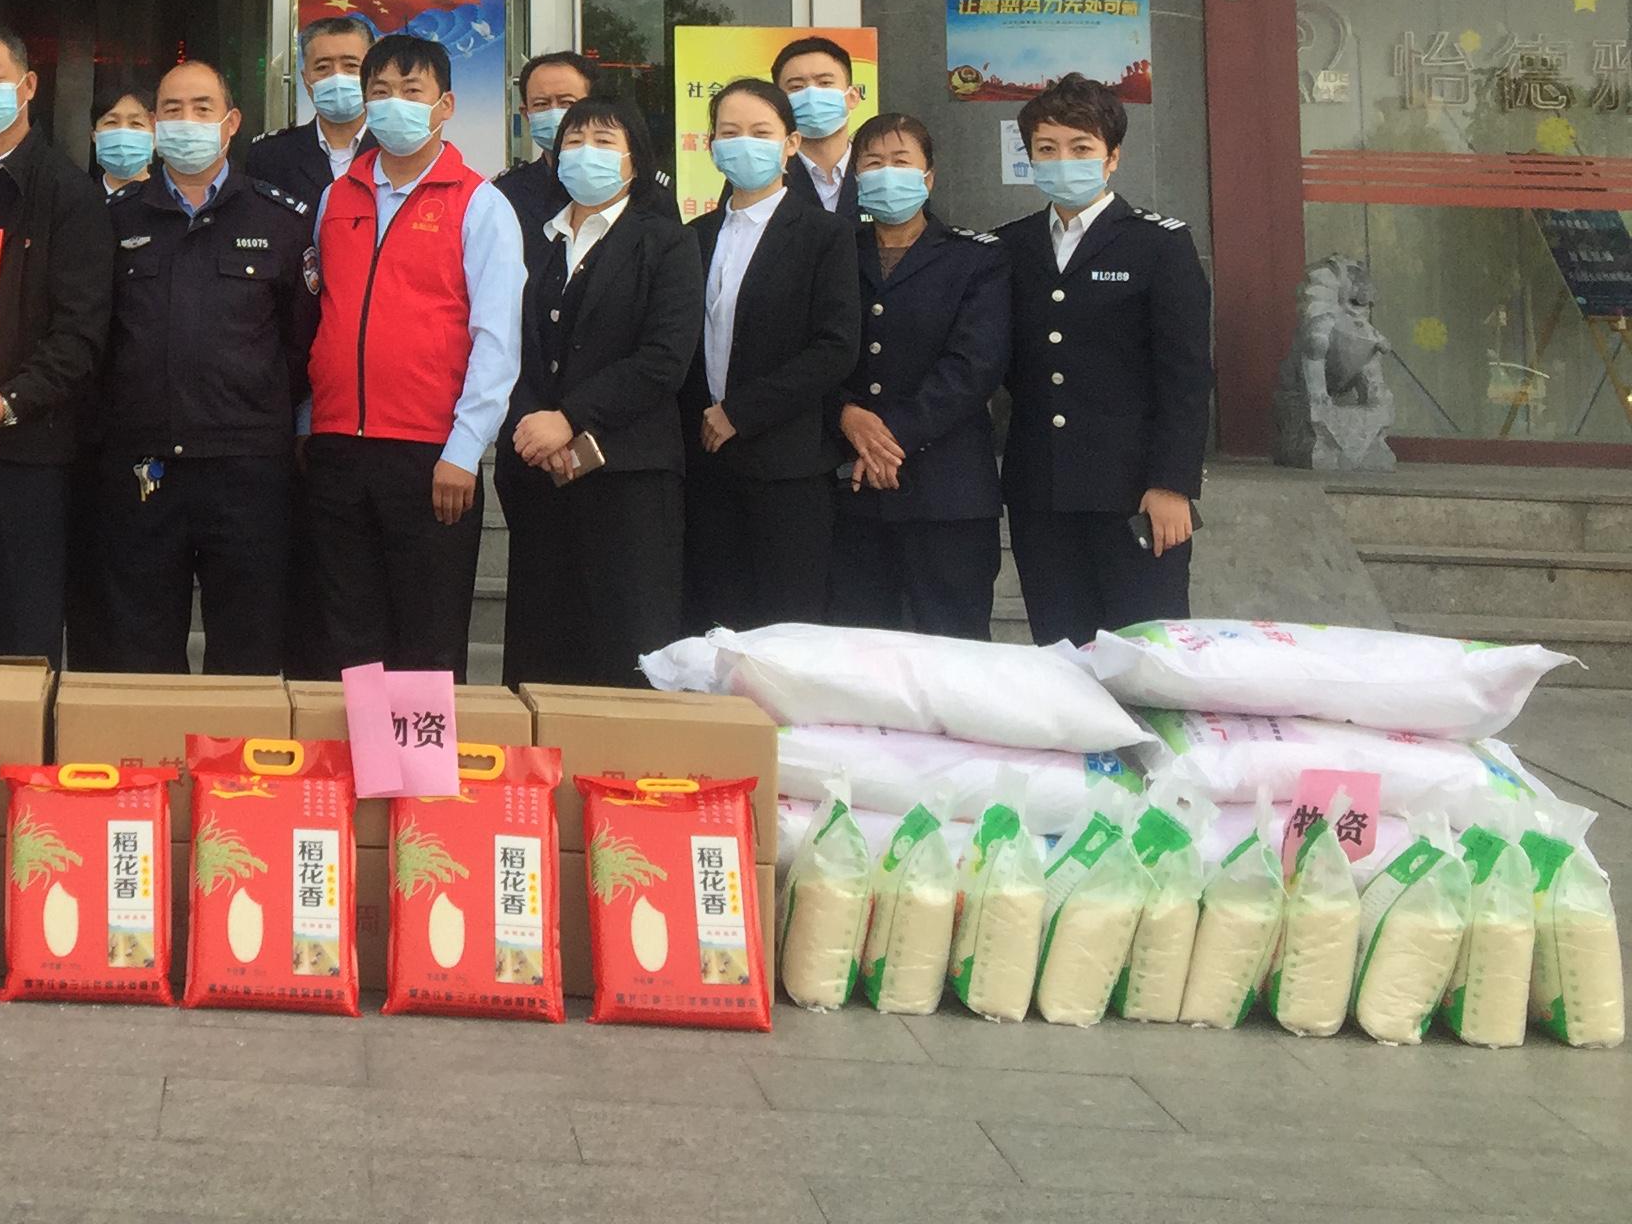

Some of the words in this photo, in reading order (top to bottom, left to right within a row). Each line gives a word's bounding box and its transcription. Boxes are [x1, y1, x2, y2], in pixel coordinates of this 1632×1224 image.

[113, 831, 139, 900] 稻花香
[298, 839, 324, 908] 稻花香
[500, 846, 526, 916] 稻花香
[696, 847, 727, 917] 稻花香
